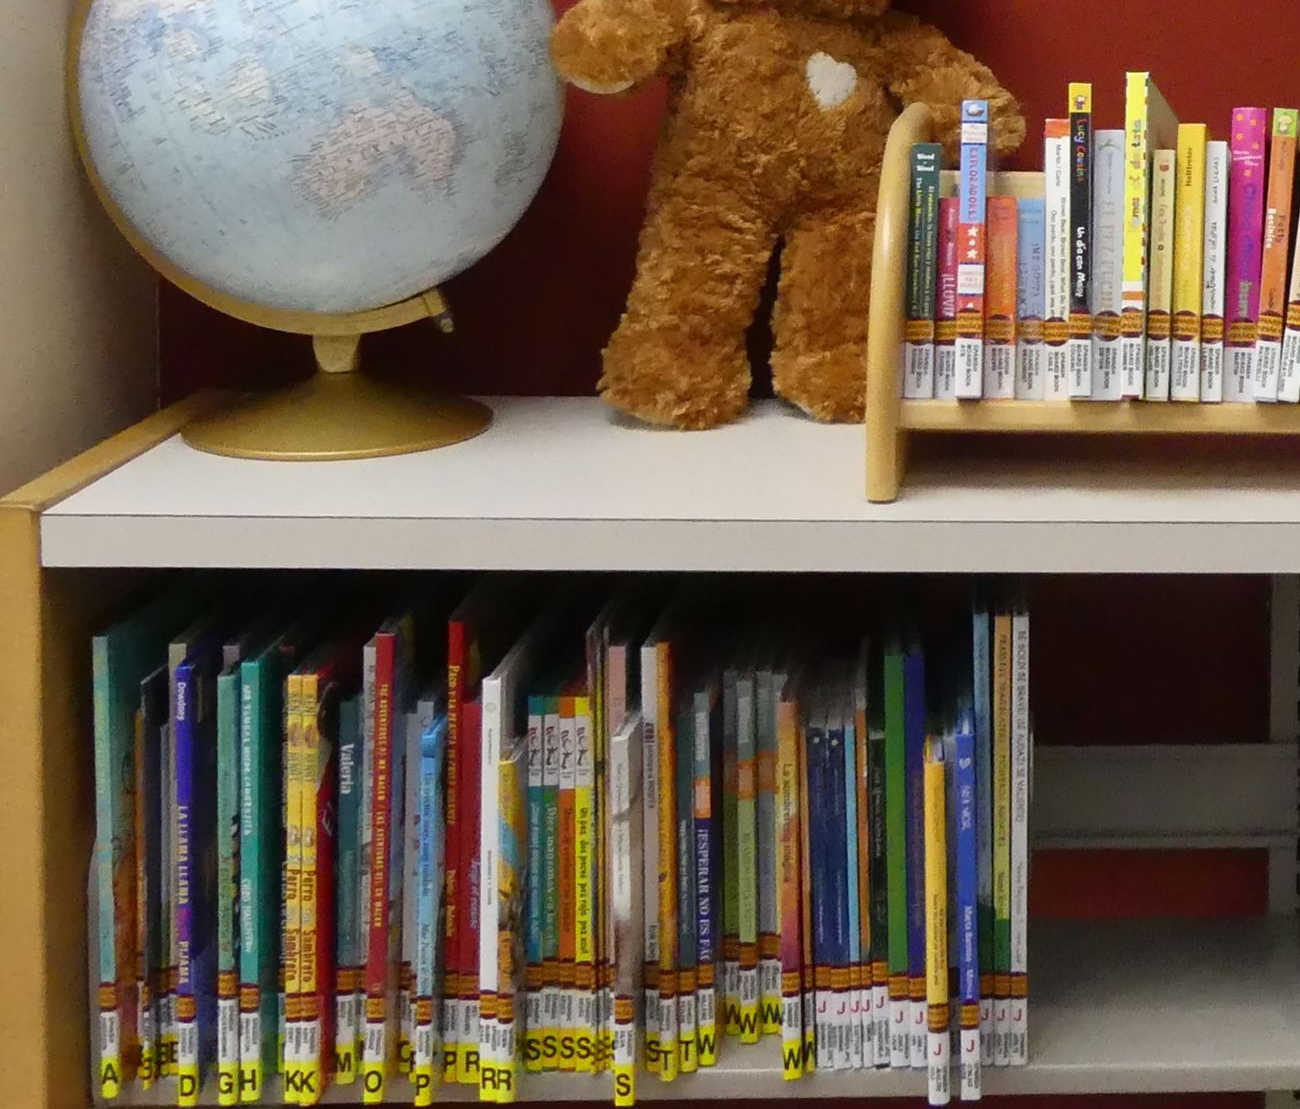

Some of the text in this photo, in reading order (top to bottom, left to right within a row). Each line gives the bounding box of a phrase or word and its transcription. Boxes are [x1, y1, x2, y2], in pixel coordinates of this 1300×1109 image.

[1073, 118, 1086, 143] Lucy
[1076, 145, 1085, 181] Cousins
[1076, 226, 1085, 238] Un
[448, 665, 460, 687] PACO
[340, 743, 354, 794] Valeria
[303, 870, 315, 902] Perro
[698, 829, 710, 935] ¡ESPERAR NO ES
[178, 806, 189, 984] LA LLAMA LLAMA PIJAMA
[818, 1000, 826, 1013] J
[837, 1002, 845, 1014] J
[851, 1000, 860, 1013] J
[862, 1000, 870, 1012] J
[876, 996, 884, 1009] J
[739, 1013, 757, 1034] W
[896, 1011, 904, 1023] J
[916, 1011, 923, 1024] J
[981, 1008, 989, 1021] J
[998, 1009, 1005, 1021] J
[1014, 1008, 1022, 1021] J
[527, 1039, 540, 1060] S
[543, 1036, 557, 1058] S
[561, 1037, 575, 1059] S
[576, 1037, 590, 1058] S
[678, 1040, 694, 1061] T
[699, 1034, 715, 1055] W
[934, 1043, 941, 1055] J
[967, 1040, 974, 1052] J
[335, 1051, 351, 1073] M
[444, 1051, 457, 1072] P
[465, 1051, 480, 1072] R
[659, 1049, 672, 1071] T
[783, 1048, 800, 1070] W
[102, 1063, 118, 1085] A
[219, 1072, 233, 1094] G
[240, 1070, 256, 1090] H
[365, 1071, 382, 1092] O
[416, 1074, 430, 1095] P
[482, 1068, 496, 1090] R
[497, 1069, 511, 1091] R
[616, 1073, 630, 1096] S
[179, 1074, 196, 1096] D
